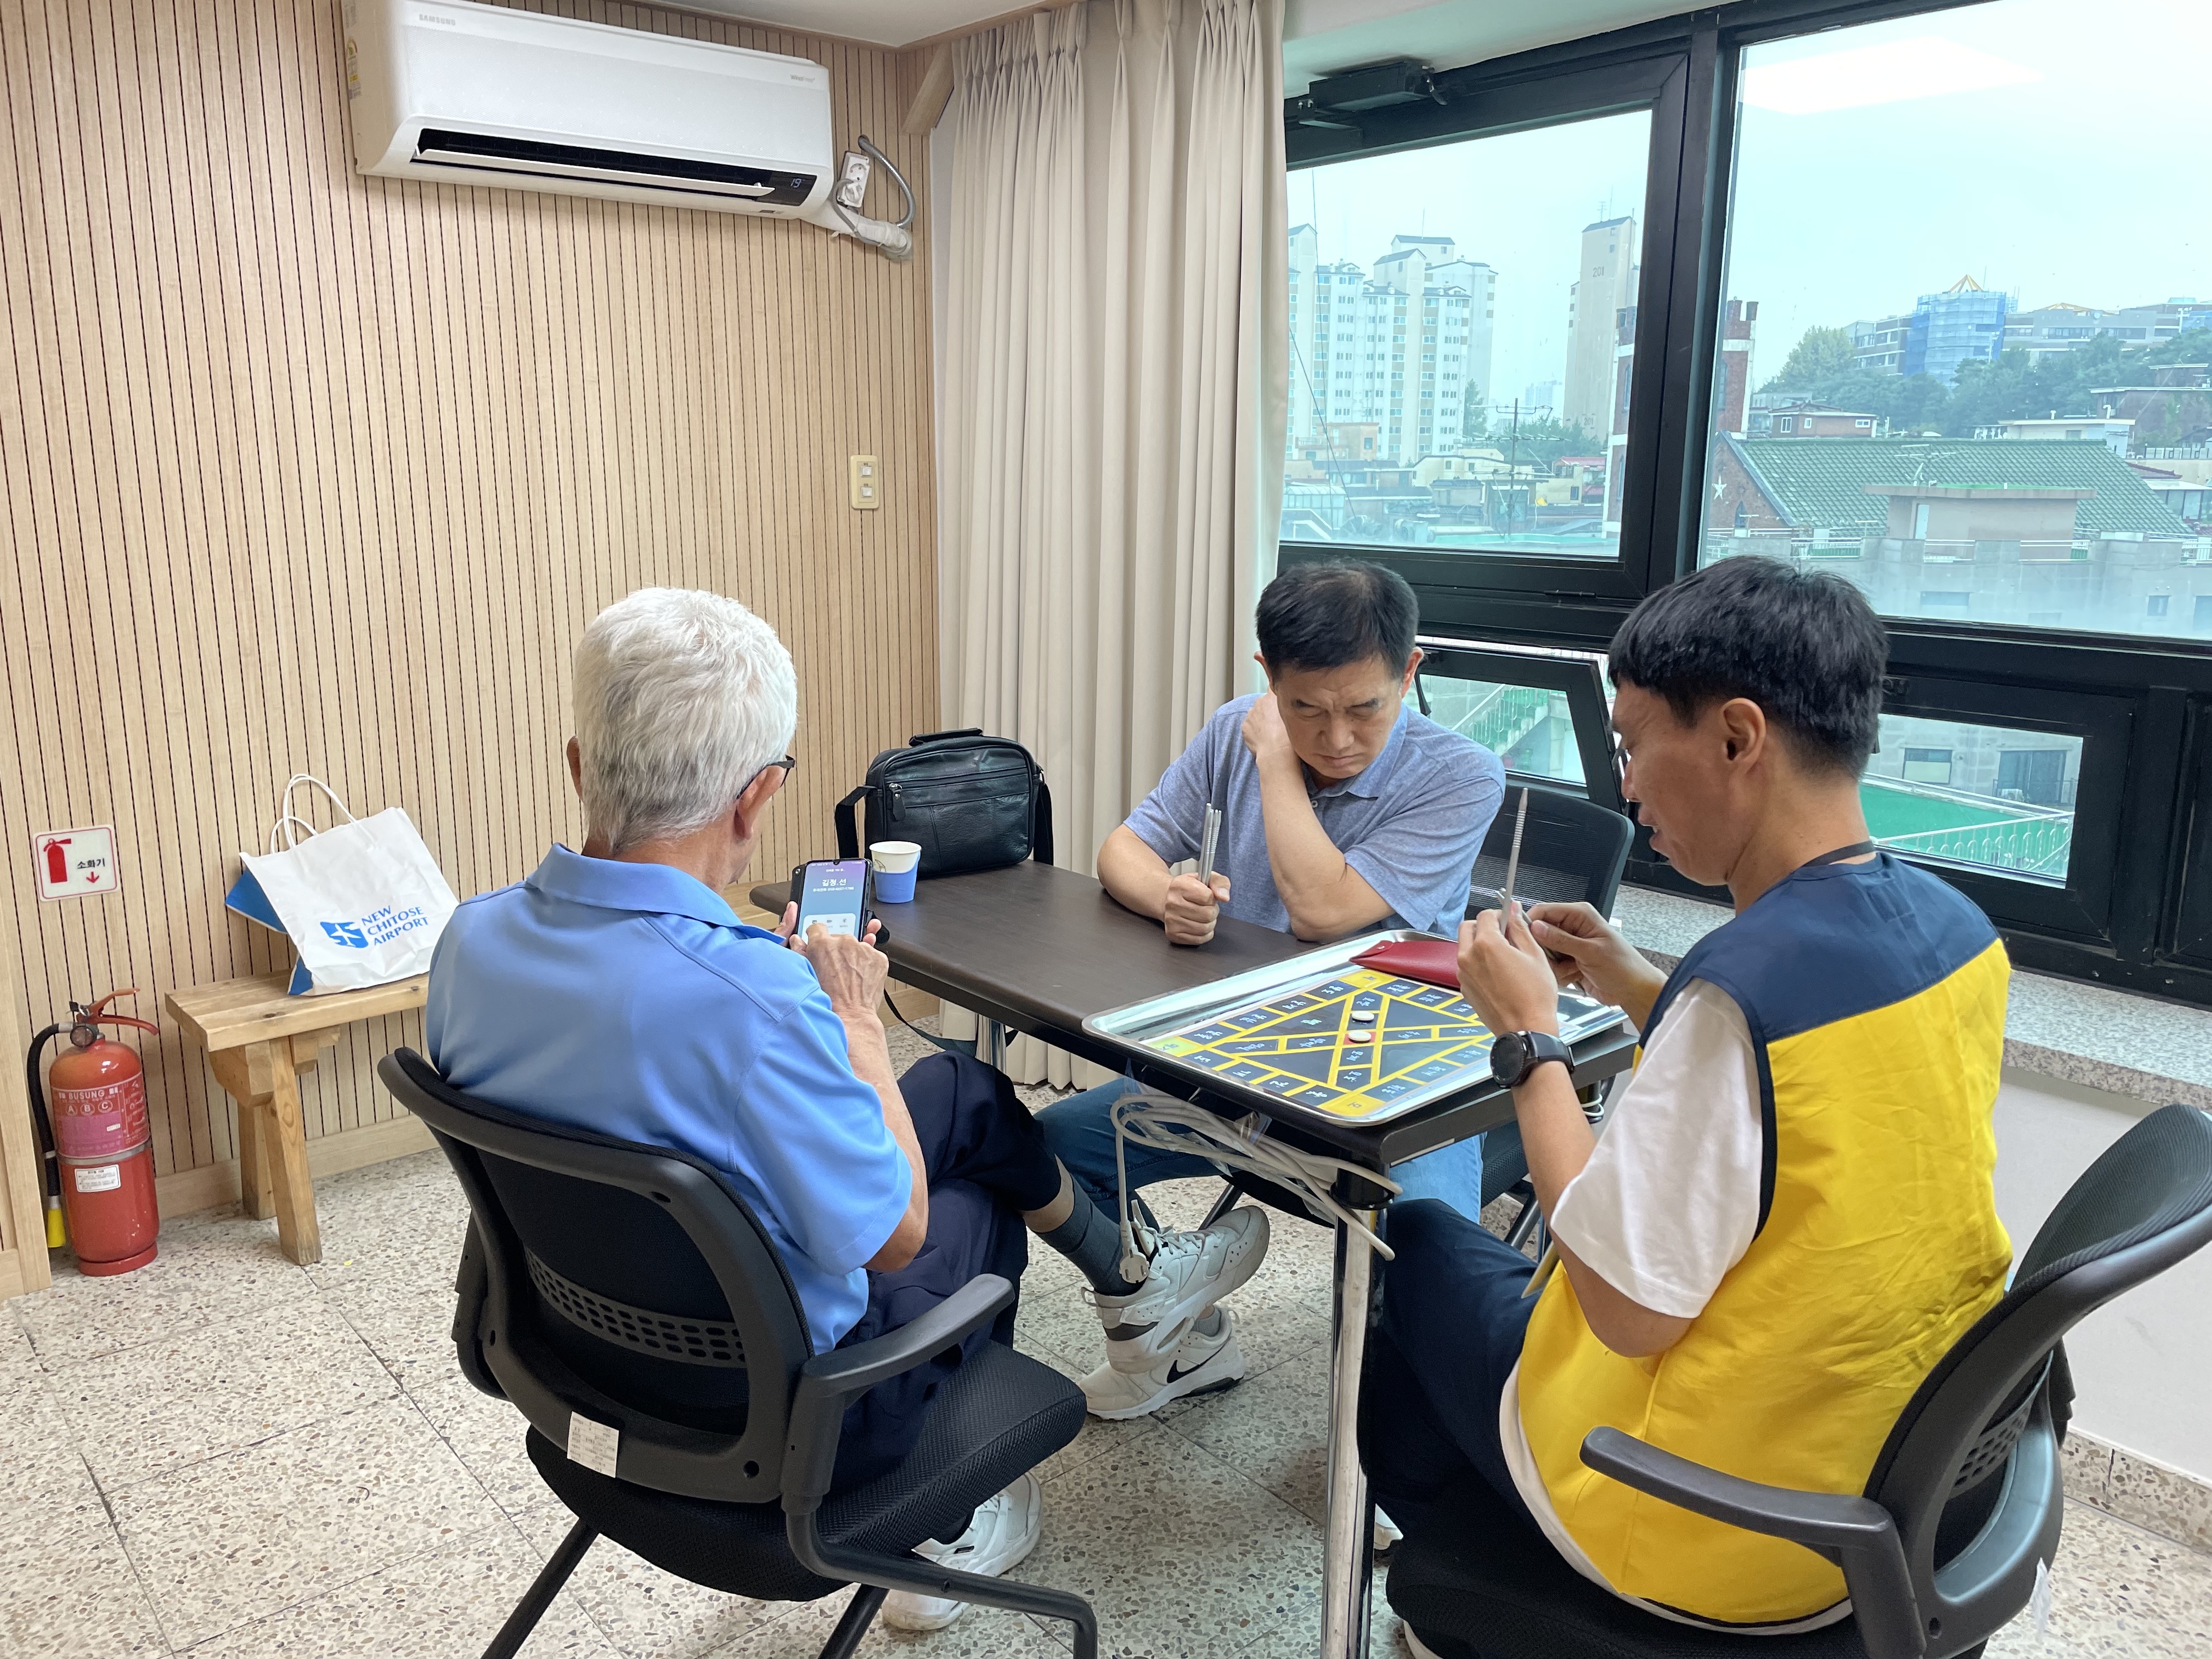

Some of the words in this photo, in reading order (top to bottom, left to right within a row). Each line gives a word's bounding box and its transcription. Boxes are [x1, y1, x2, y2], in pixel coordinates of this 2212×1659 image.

[1593, 266, 1605, 277] 201
[77, 857, 105, 870] 소화기
[362, 905, 391, 926] NEW
[368, 906, 424, 935] CHITOSE
[374, 917, 428, 946] AIRPORT
[69, 1089, 105, 1100] BUSUNG
[68, 1104, 75, 1113] A
[84, 1104, 91, 1113] B
[101, 1101, 109, 1110] C
